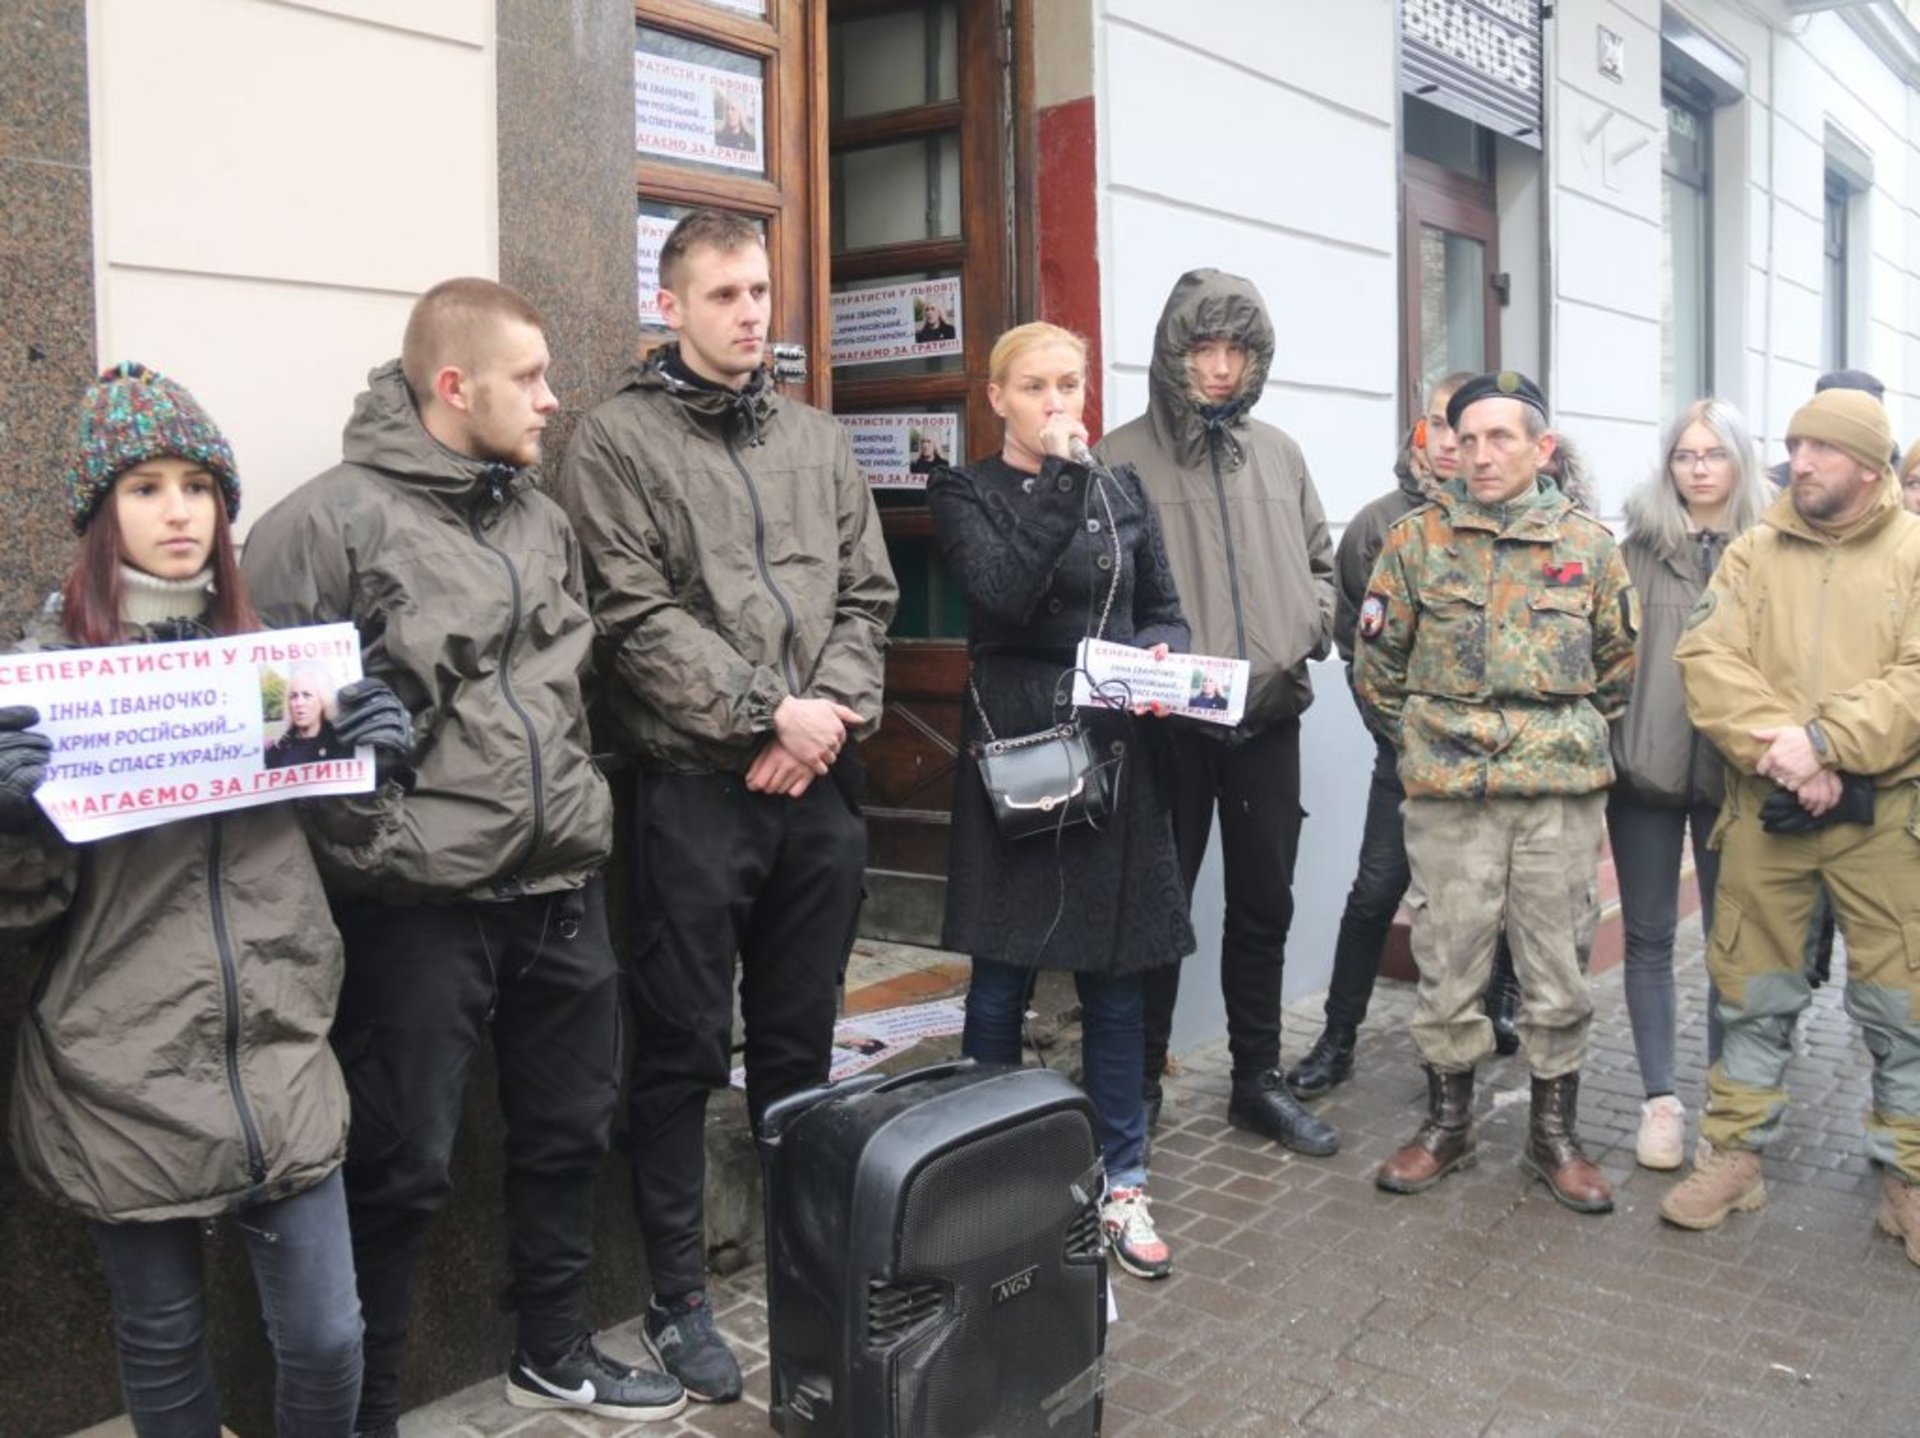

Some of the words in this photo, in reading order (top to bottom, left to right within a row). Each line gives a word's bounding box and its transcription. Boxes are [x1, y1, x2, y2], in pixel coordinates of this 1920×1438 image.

[222, 648, 238, 667] У
[49, 700, 104, 721] ІННА
[110, 689, 217, 716] ІВАНОЧКО
[108, 753, 166, 774] СПАСЕ
[210, 777, 242, 797] ЗА
[253, 760, 364, 790] ГРАТИ!!!
[998, 1272, 1033, 1301] NGS
